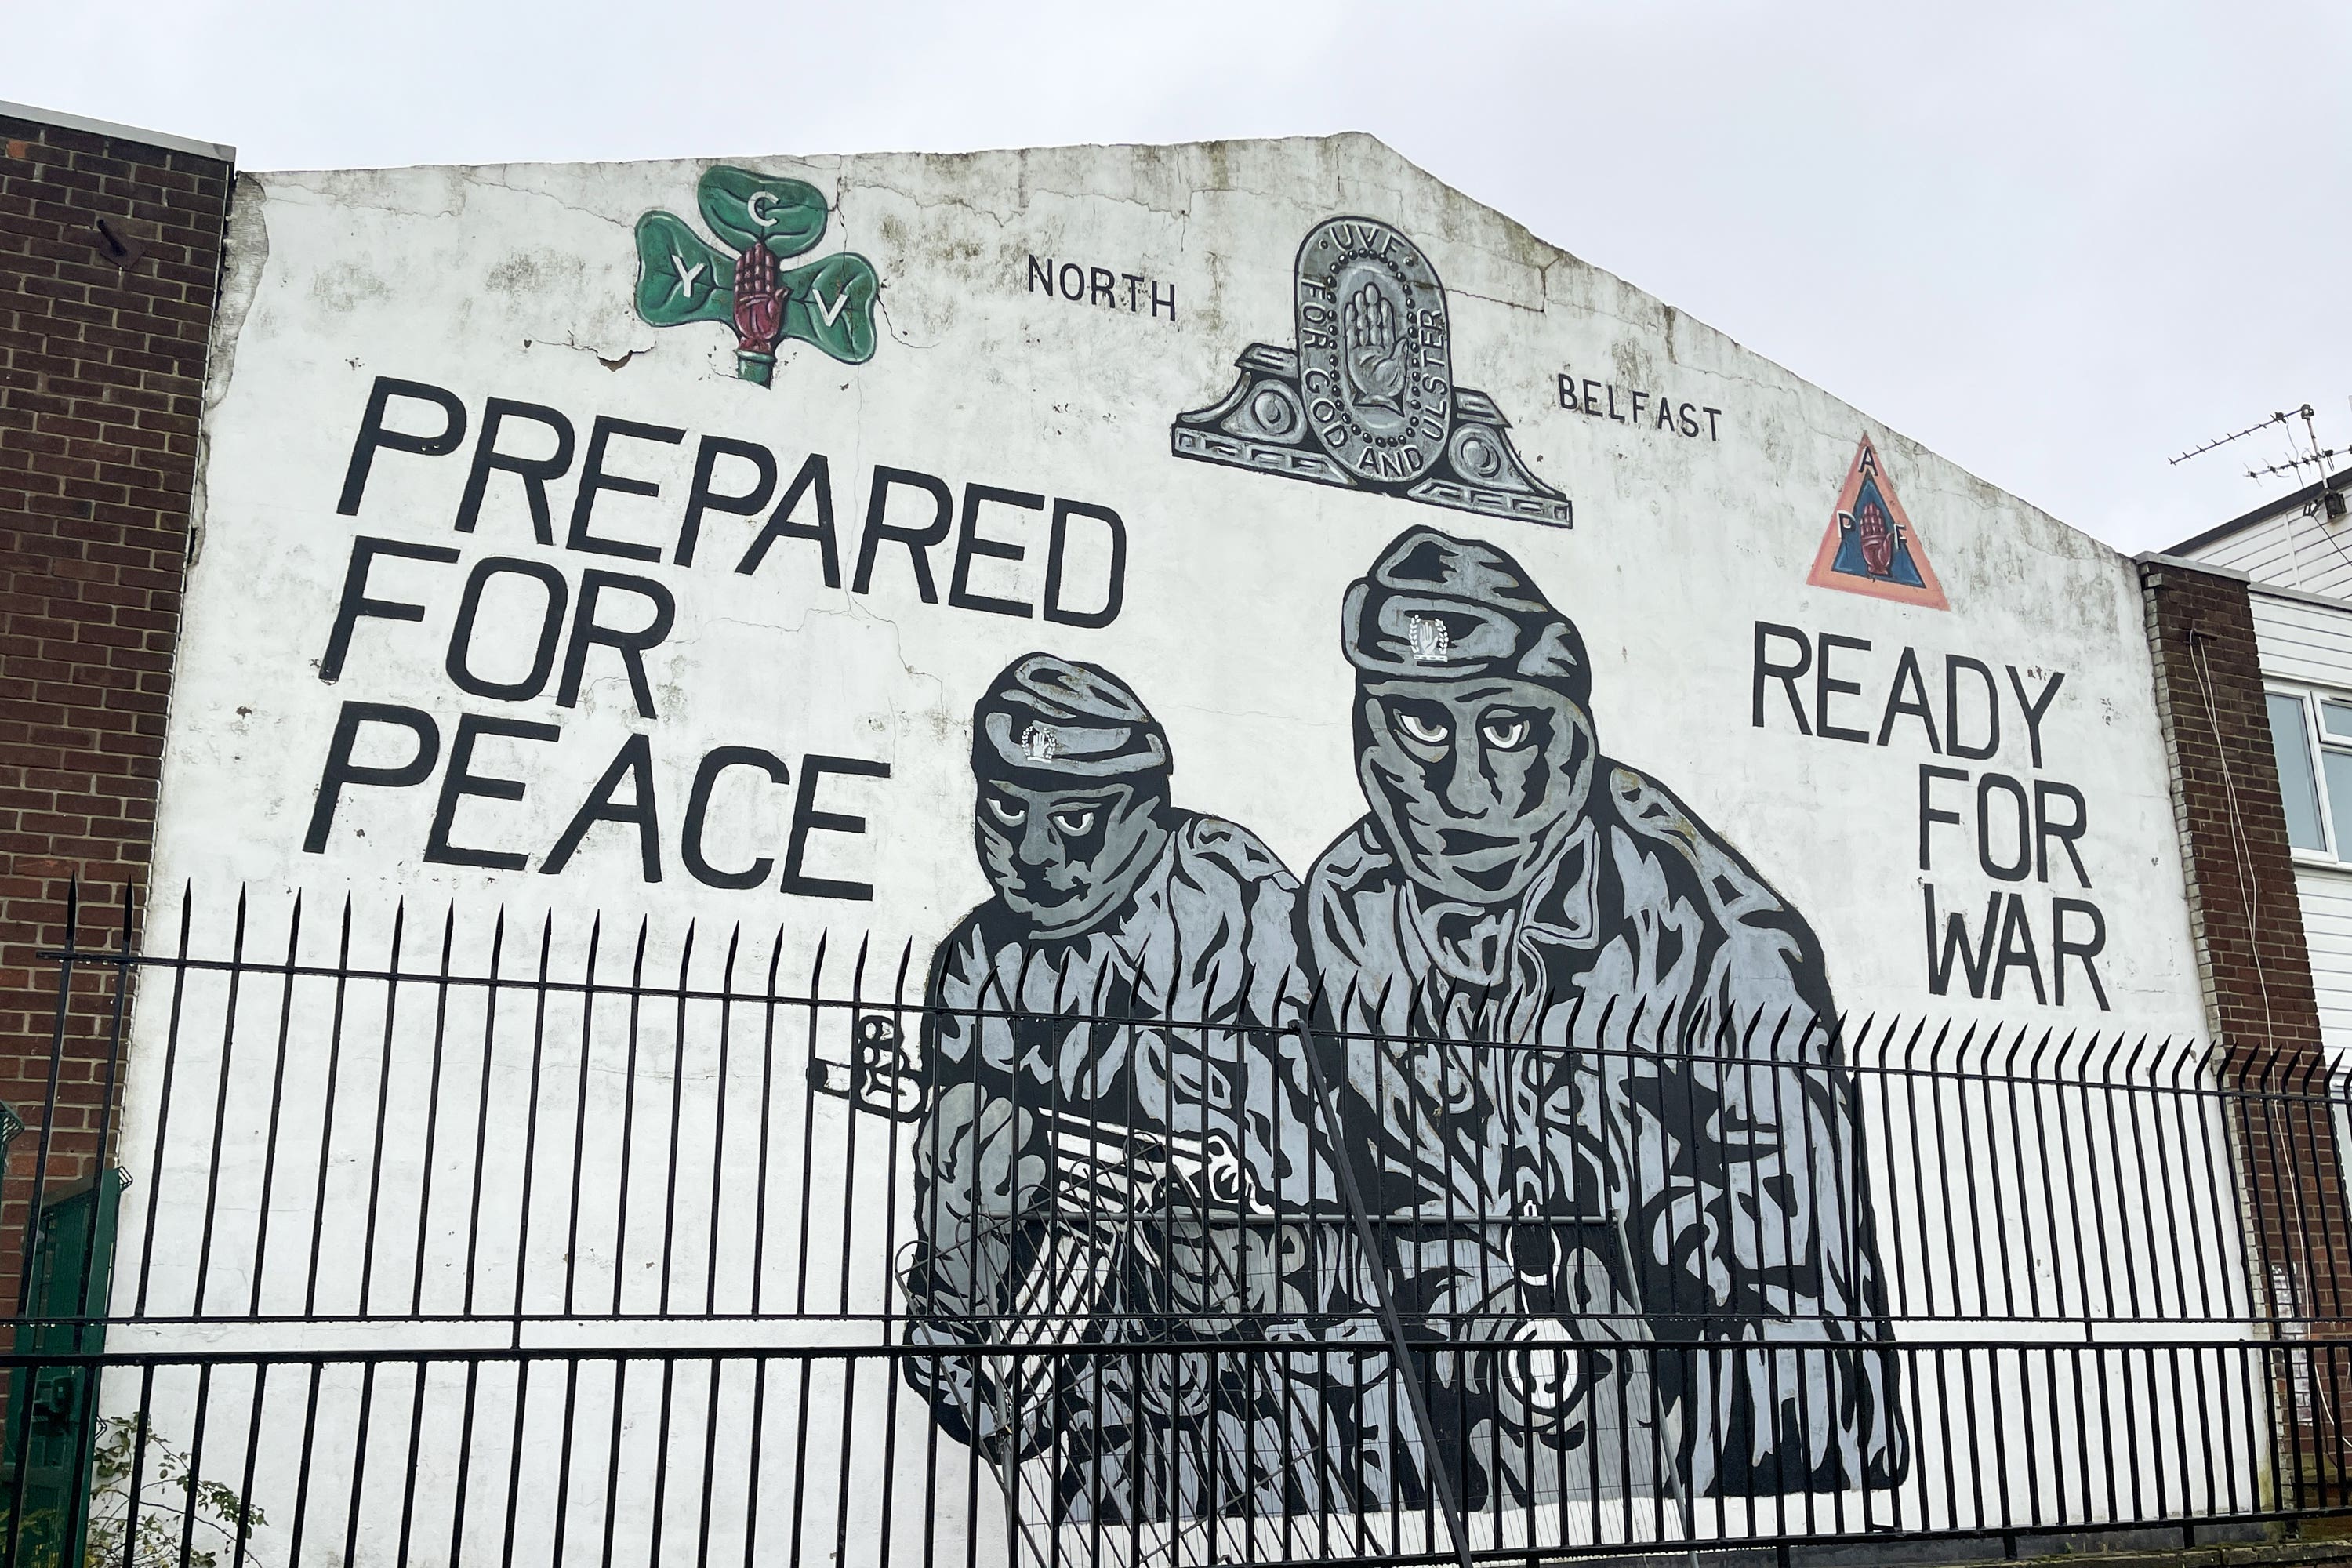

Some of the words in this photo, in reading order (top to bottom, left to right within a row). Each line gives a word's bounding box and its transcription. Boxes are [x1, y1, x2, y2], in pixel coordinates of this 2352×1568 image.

[1028, 253, 1176, 322] NORTH
[1328, 223, 1406, 258] UVF
[1300, 278, 1330, 349] FOR
[1356, 445, 1425, 478] AND
[1416, 307, 1449, 441] ULSTER
[1557, 372, 1722, 447] BELFAST
[336, 376, 1127, 630] PREPARED
[318, 535, 676, 720] FOR
[1752, 620, 2066, 769] READY
[302, 700, 891, 902] PEACE
[1919, 763, 2093, 889] FOR
[1923, 883, 2111, 1011] WAR
